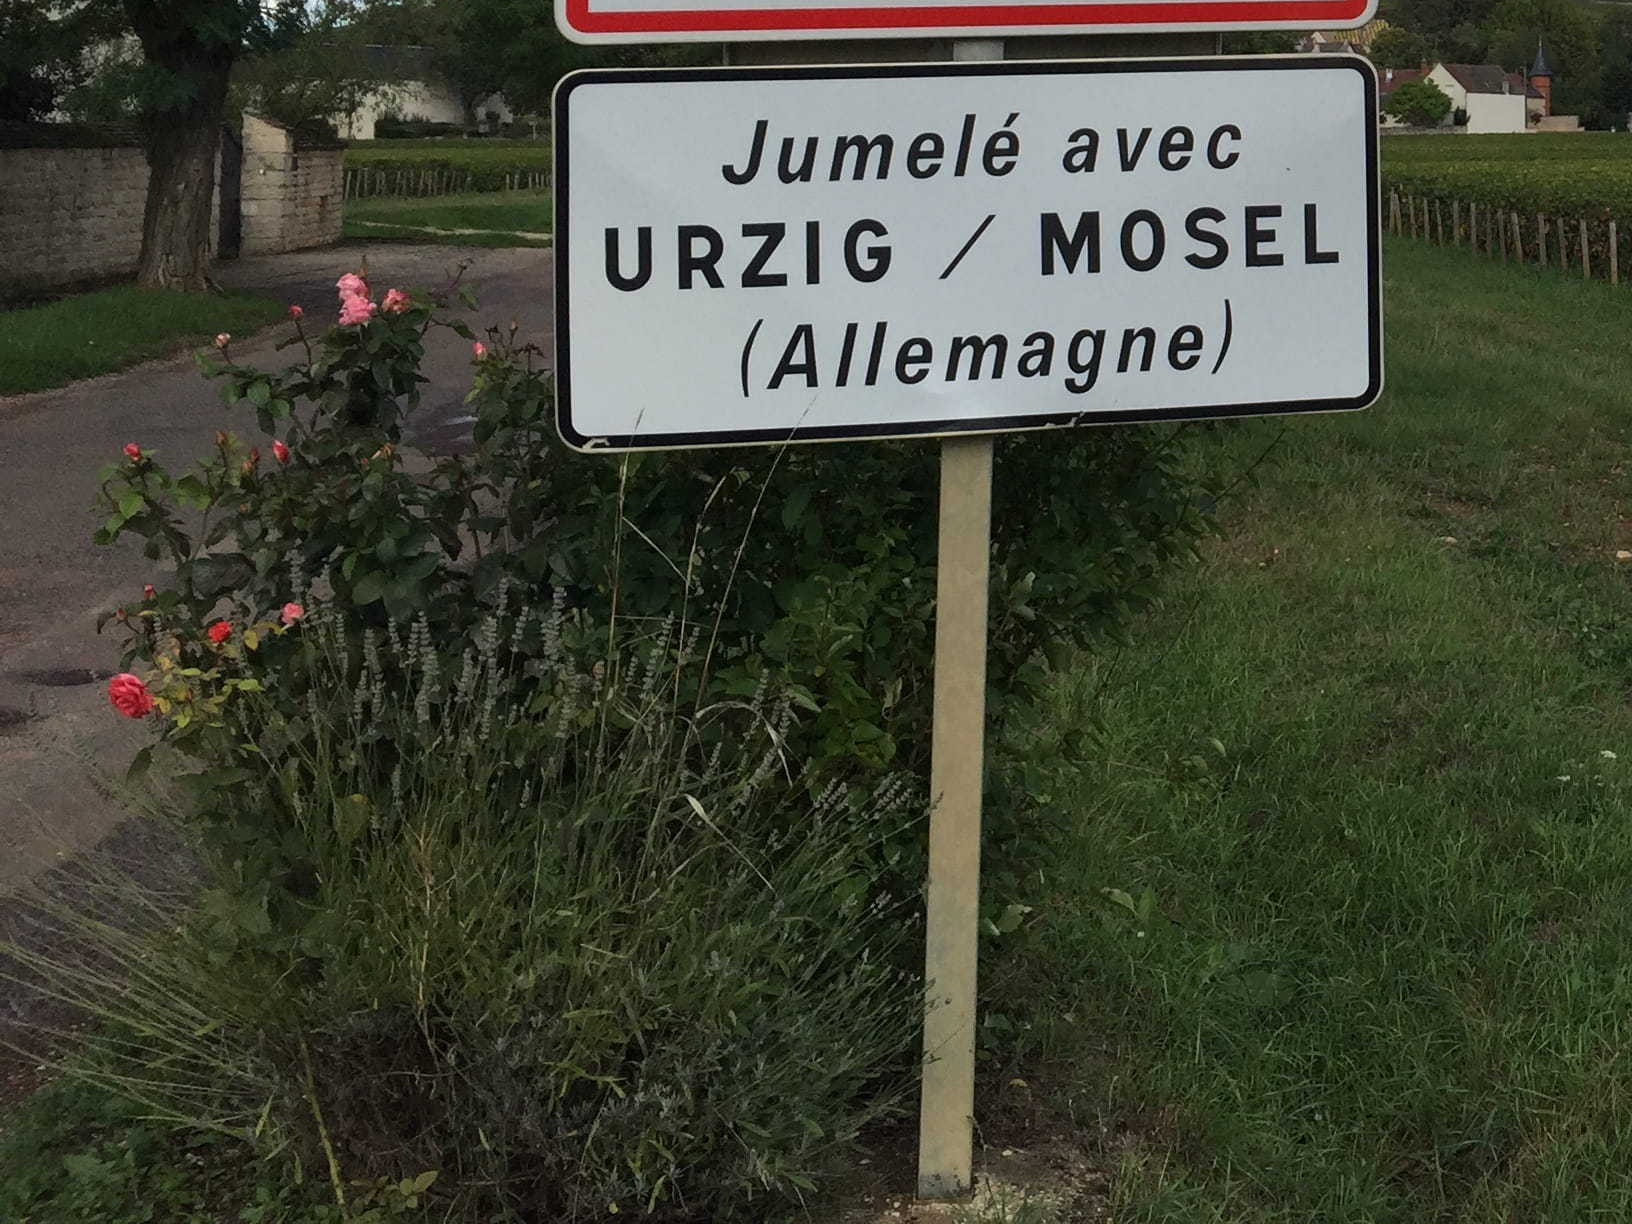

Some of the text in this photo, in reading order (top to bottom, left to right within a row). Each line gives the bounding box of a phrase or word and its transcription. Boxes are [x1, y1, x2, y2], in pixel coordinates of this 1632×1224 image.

[721, 112, 1242, 186] Jumelé avec
[604, 203, 1340, 292] URZIG / MOSEL
[740, 298, 1233, 398] (Allemagne)
